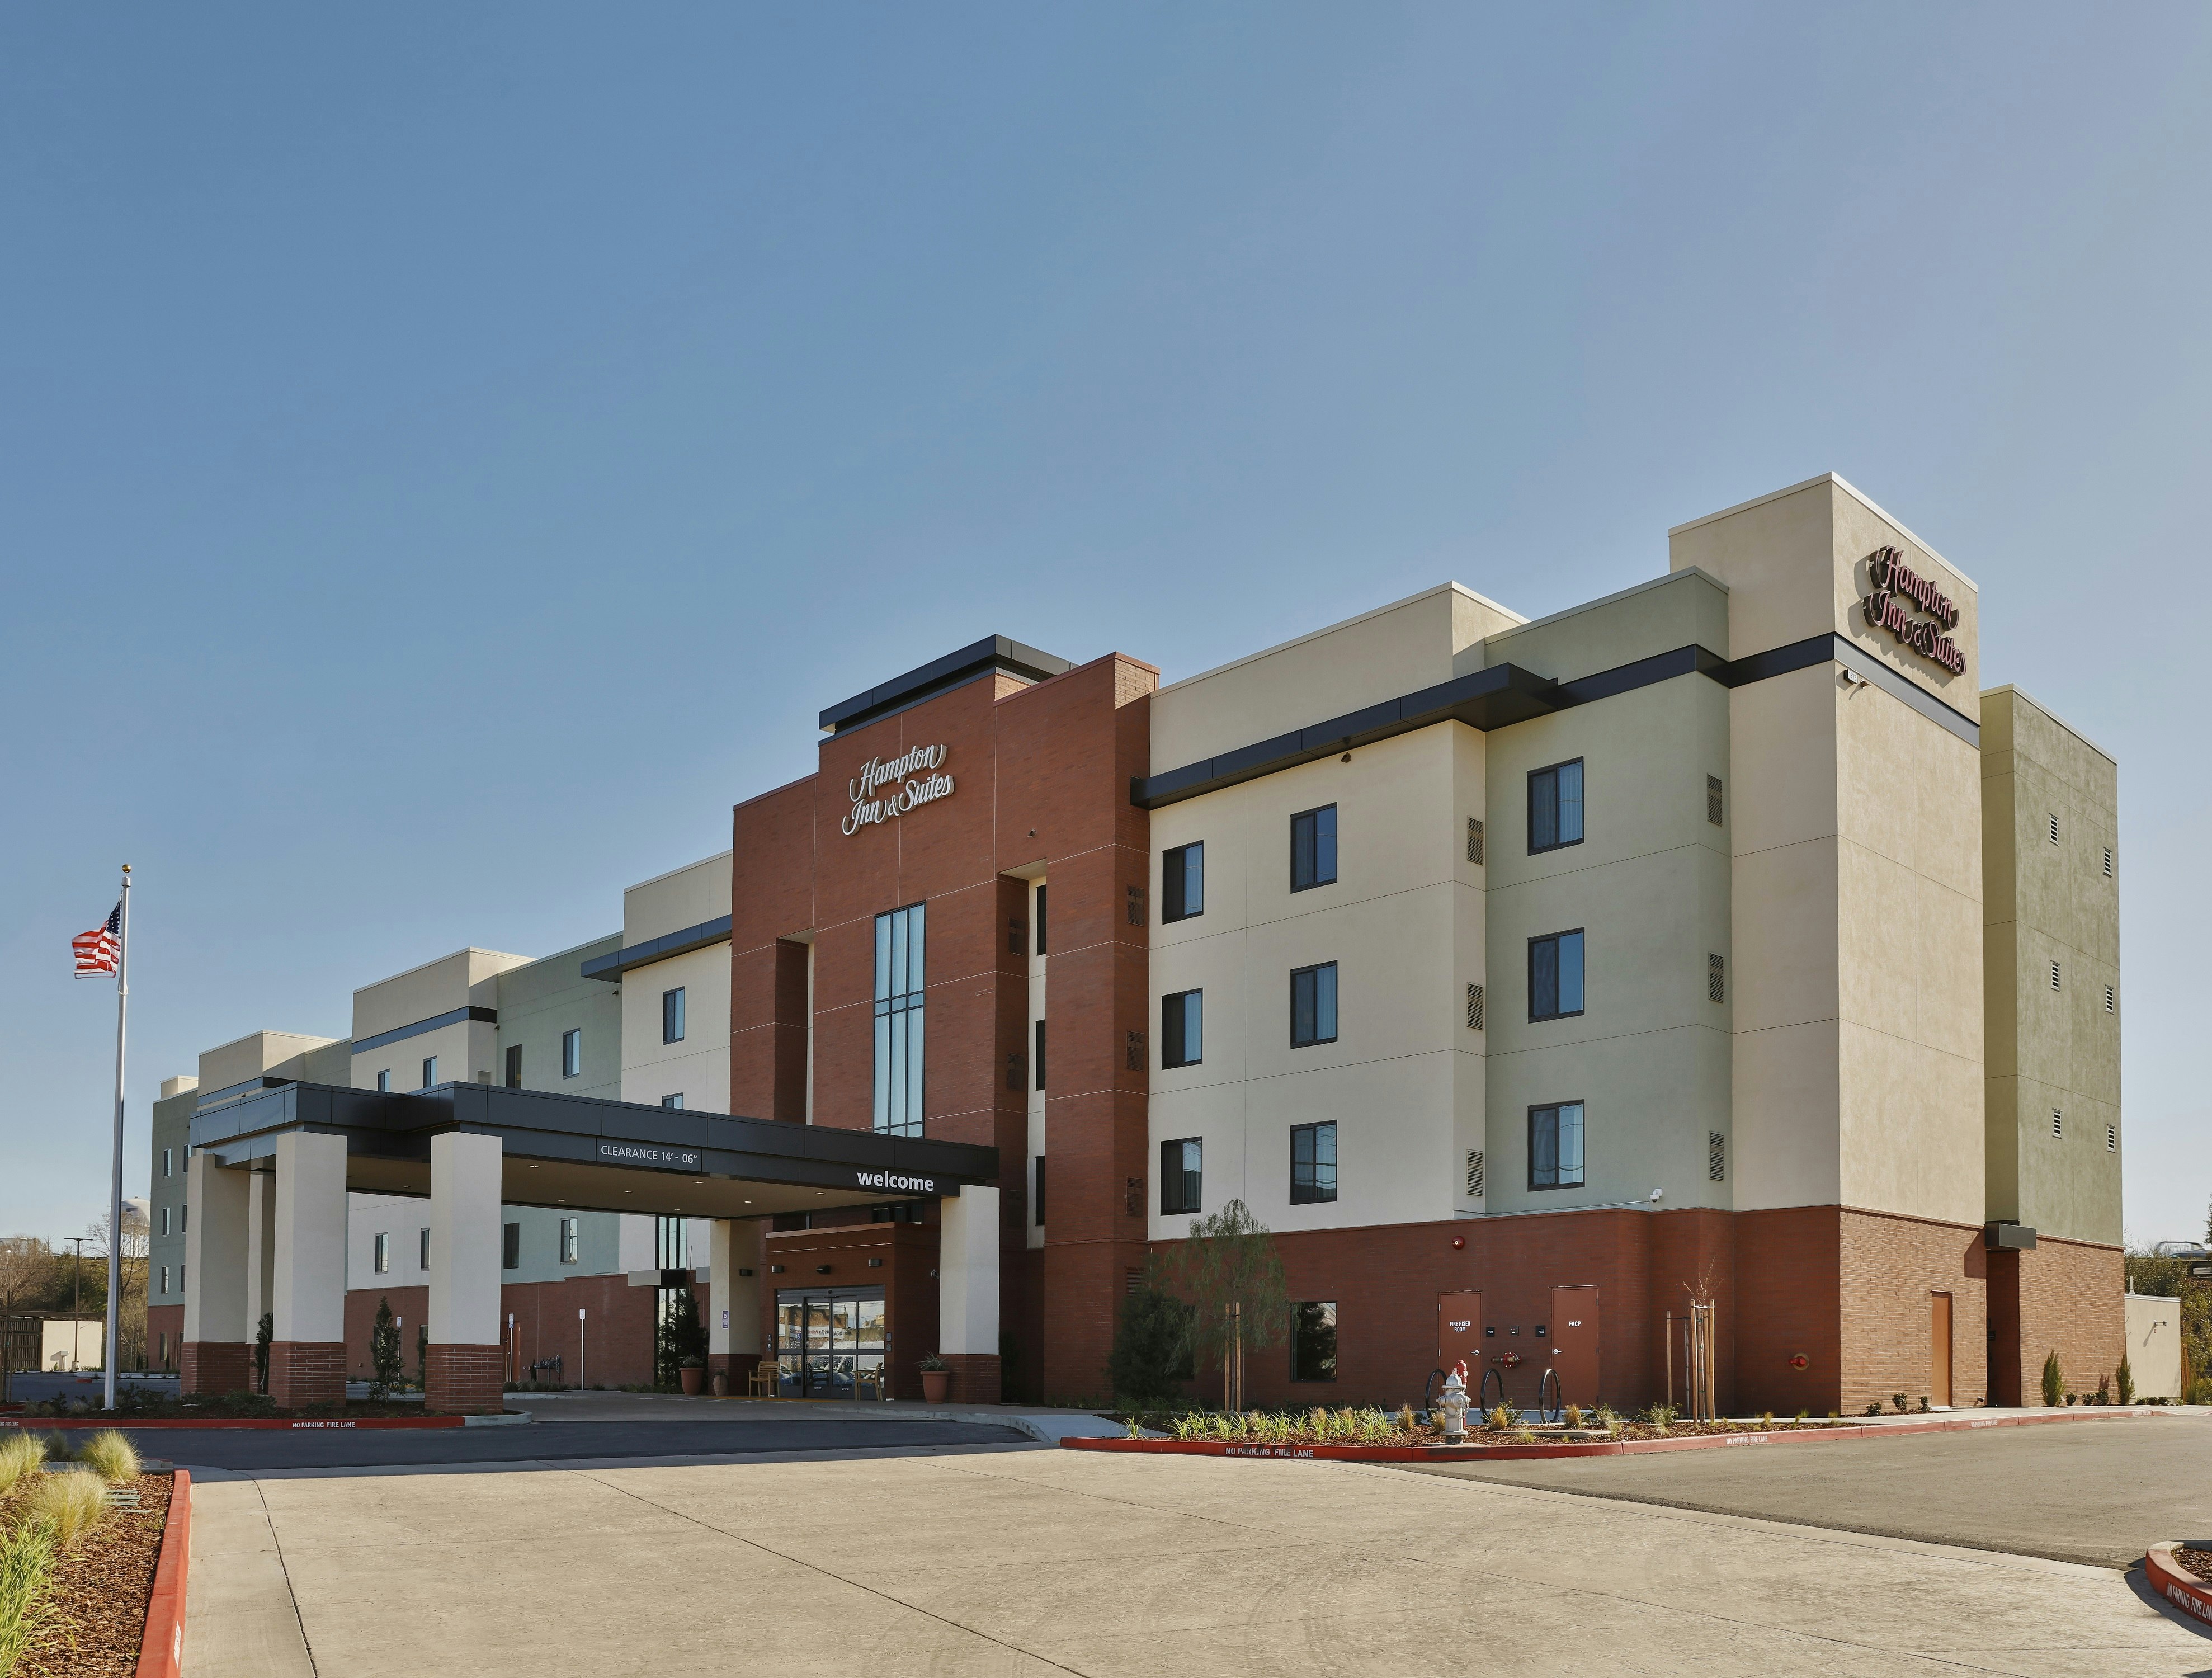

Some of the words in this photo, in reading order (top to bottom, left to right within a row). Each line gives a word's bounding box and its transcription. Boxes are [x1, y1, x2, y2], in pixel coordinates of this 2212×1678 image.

[1869, 545, 1959, 631] Hampton
[1863, 590, 1913, 644] Inn
[1923, 620, 1966, 677] Suites
[849, 743, 947, 802] Hampton
[841, 799, 888, 836] Inn
[887, 794, 903, 817] &
[898, 772, 955, 812] Suites
[601, 1145, 658, 1160] CLEARANCE
[857, 1170, 934, 1191] welcome
[1238, 1447, 1270, 1456] PARKNG
[1293, 1449, 1314, 1458] LANE
[2167, 1582, 2173, 1598] NO
[2172, 1585, 2190, 1609] PARKING
[2191, 1596, 2202, 1616] FIRE
